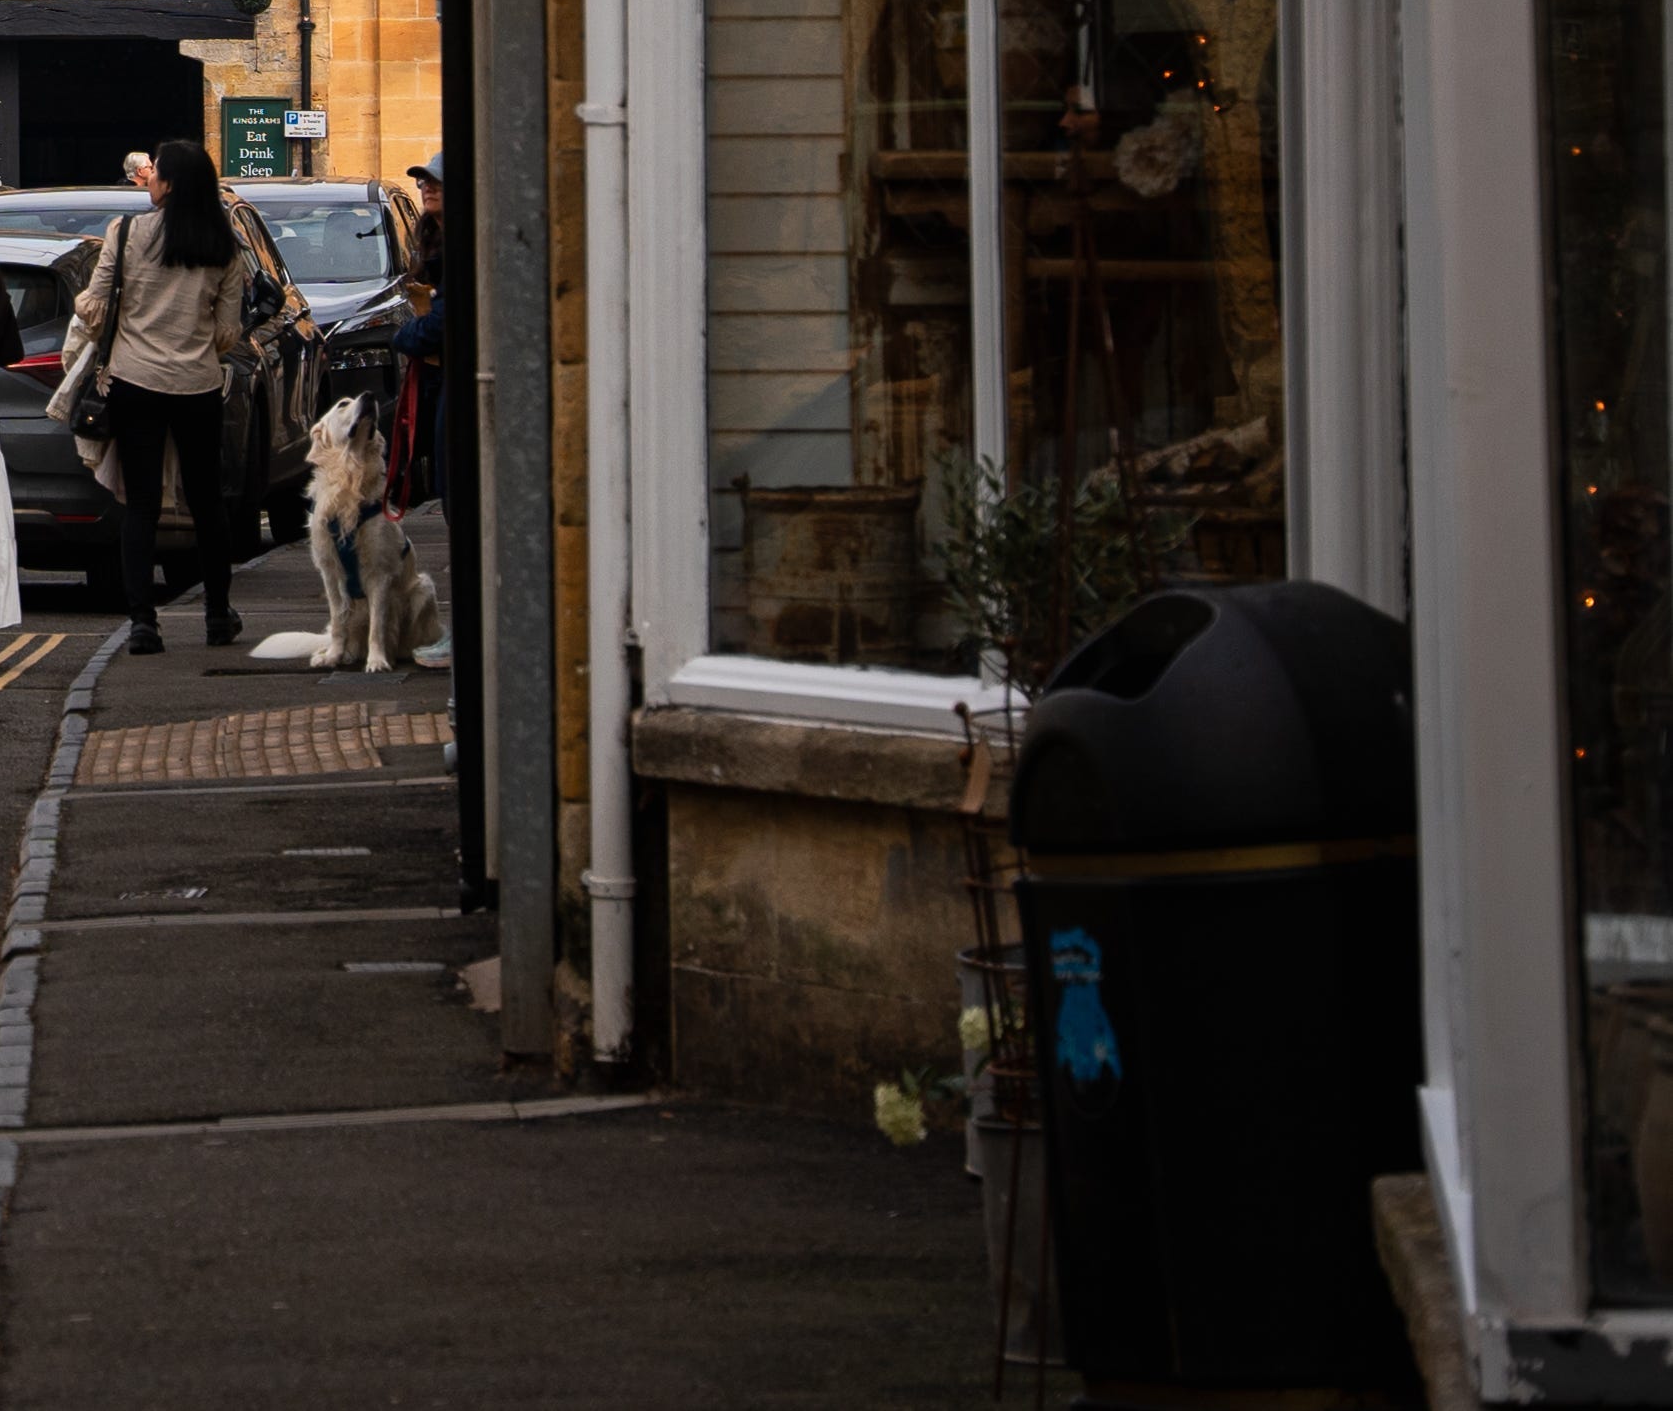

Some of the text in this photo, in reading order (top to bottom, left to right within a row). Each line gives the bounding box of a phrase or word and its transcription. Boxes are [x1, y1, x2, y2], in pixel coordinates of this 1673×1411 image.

[288, 113, 296, 123] P
[246, 131, 267, 142] Eat
[239, 147, 274, 159] Drink
[240, 163, 273, 177] Sleep
